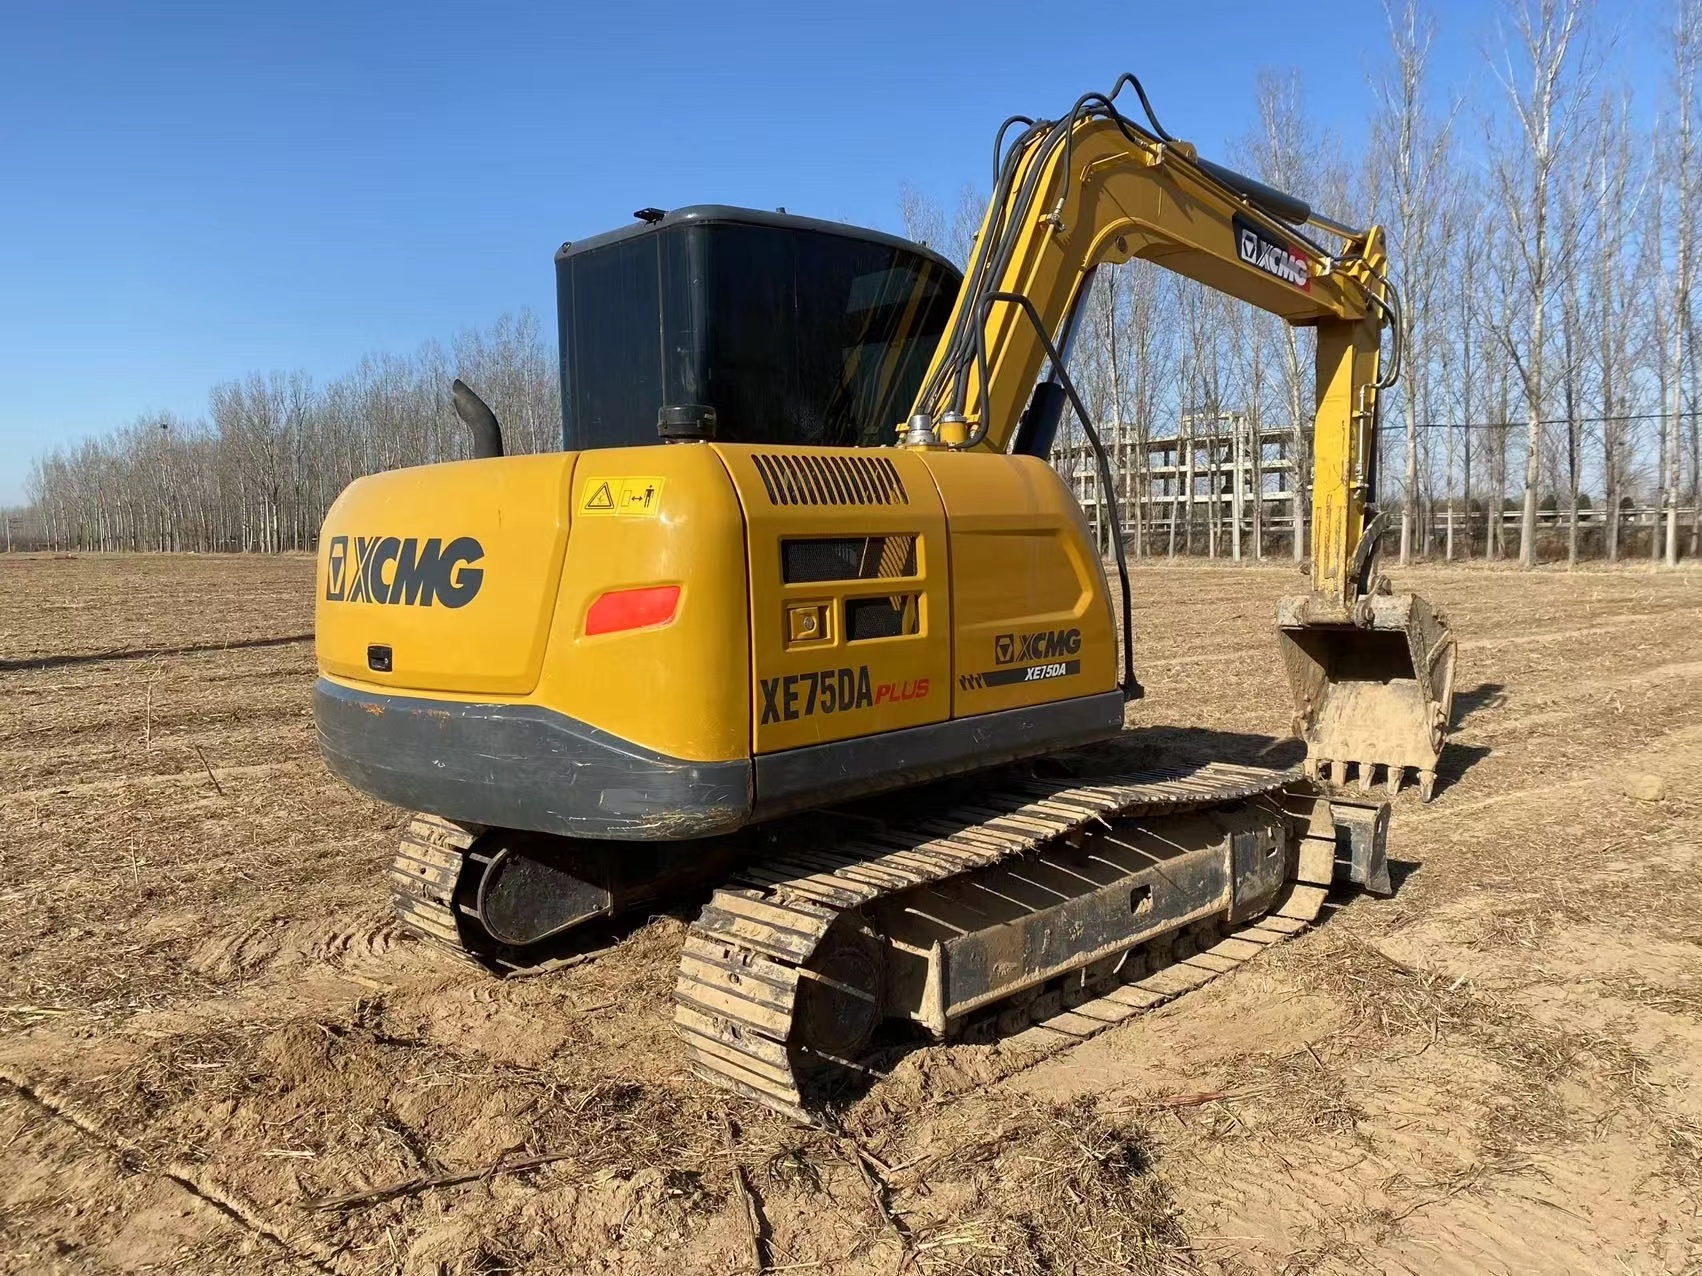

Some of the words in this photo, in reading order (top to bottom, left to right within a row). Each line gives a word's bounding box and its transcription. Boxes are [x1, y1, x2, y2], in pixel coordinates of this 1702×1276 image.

[1257, 240, 1308, 286] XCMG
[347, 536, 485, 608] XCMG
[1016, 628, 1082, 662] XCMG
[760, 665, 874, 725] XE75DA
[876, 678, 929, 705] PLUS
[1024, 665, 1067, 682] XE75DA
